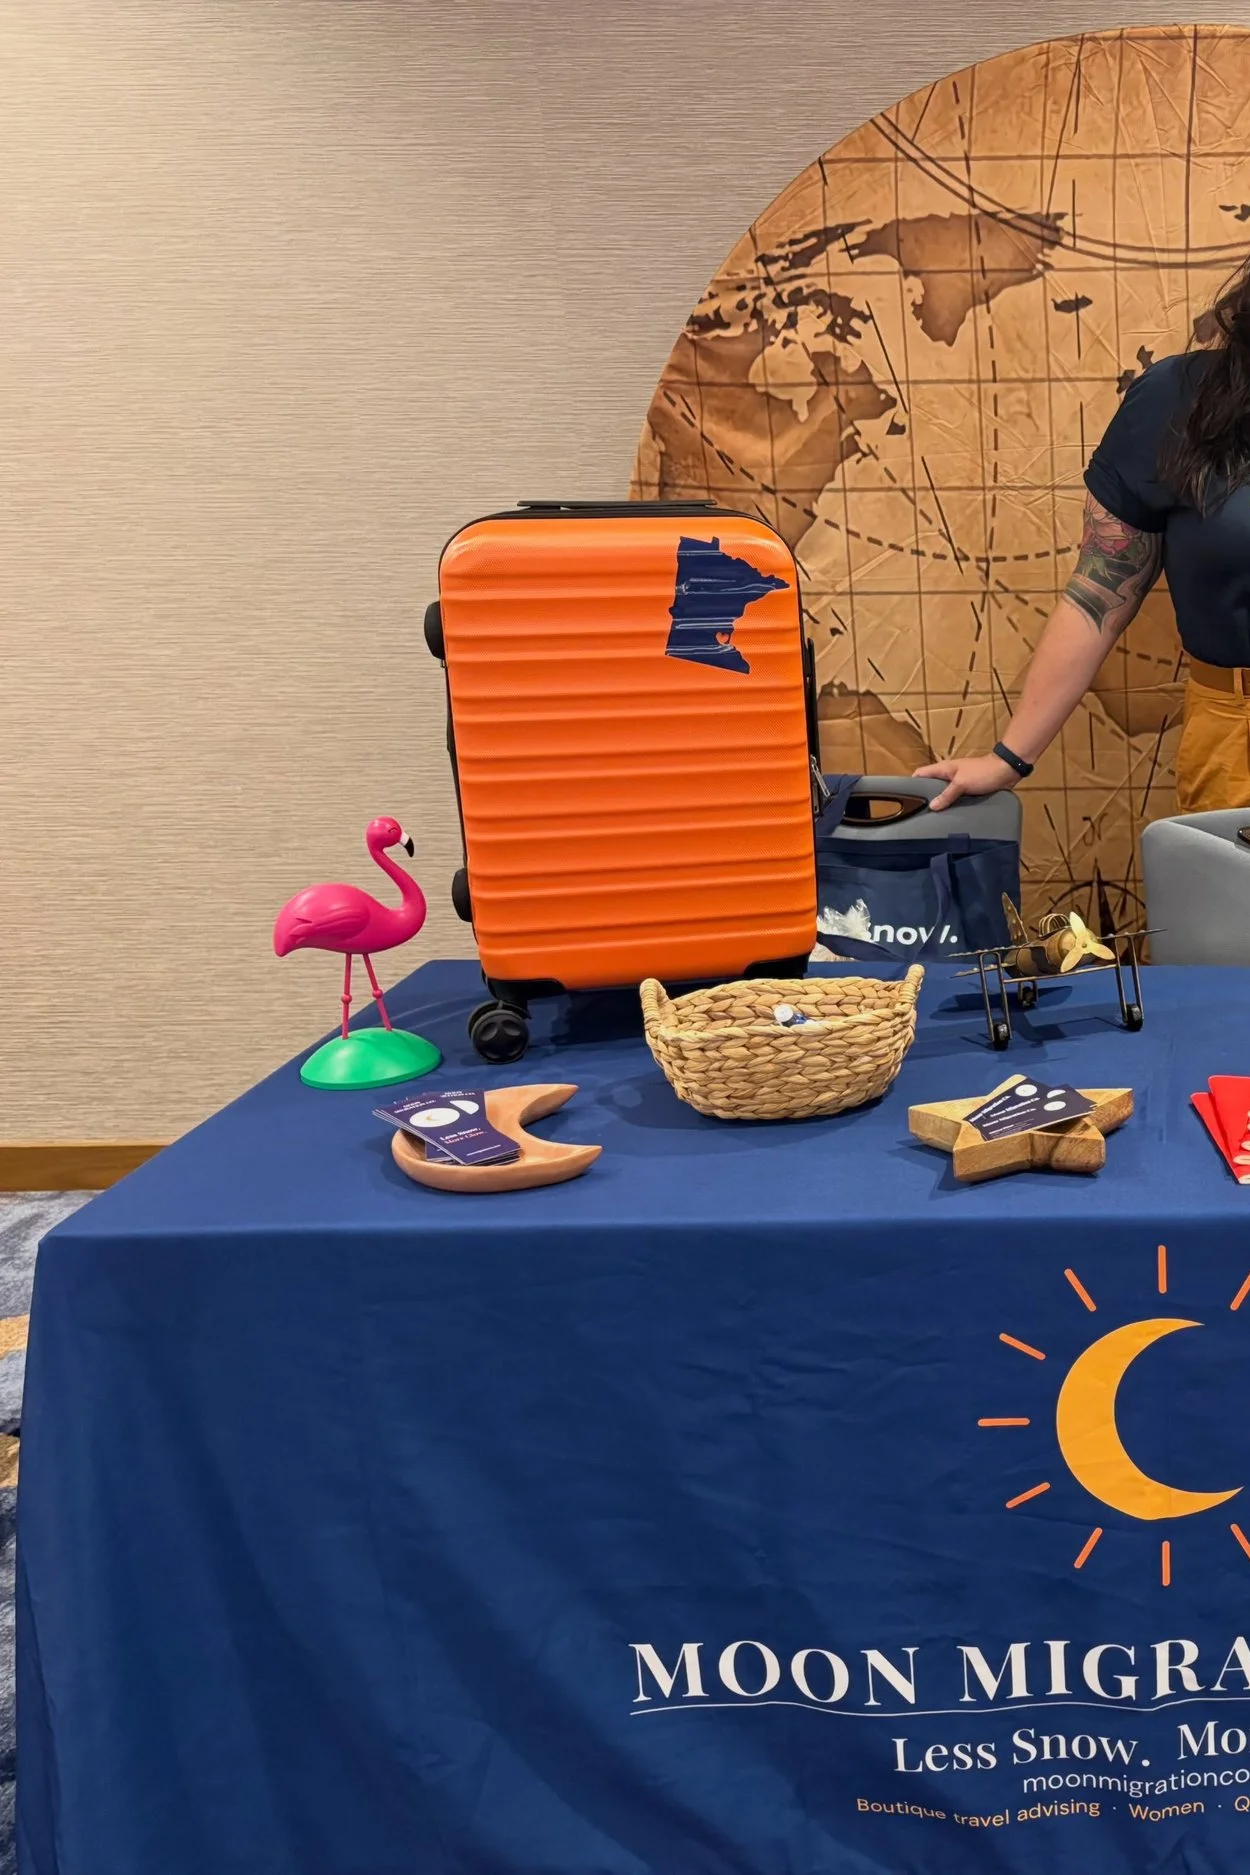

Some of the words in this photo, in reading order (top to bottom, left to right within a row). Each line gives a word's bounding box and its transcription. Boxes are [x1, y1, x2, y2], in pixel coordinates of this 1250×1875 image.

[628, 1640, 919, 1706] MOON
[891, 1738, 997, 1773] Less
[1012, 1728, 1150, 1767] Snow.
[857, 1798, 946, 1820] Boutique
[954, 1809, 1010, 1828] travel
[1017, 1799, 1100, 1822] advising
[1129, 1801, 1205, 1821] Women
